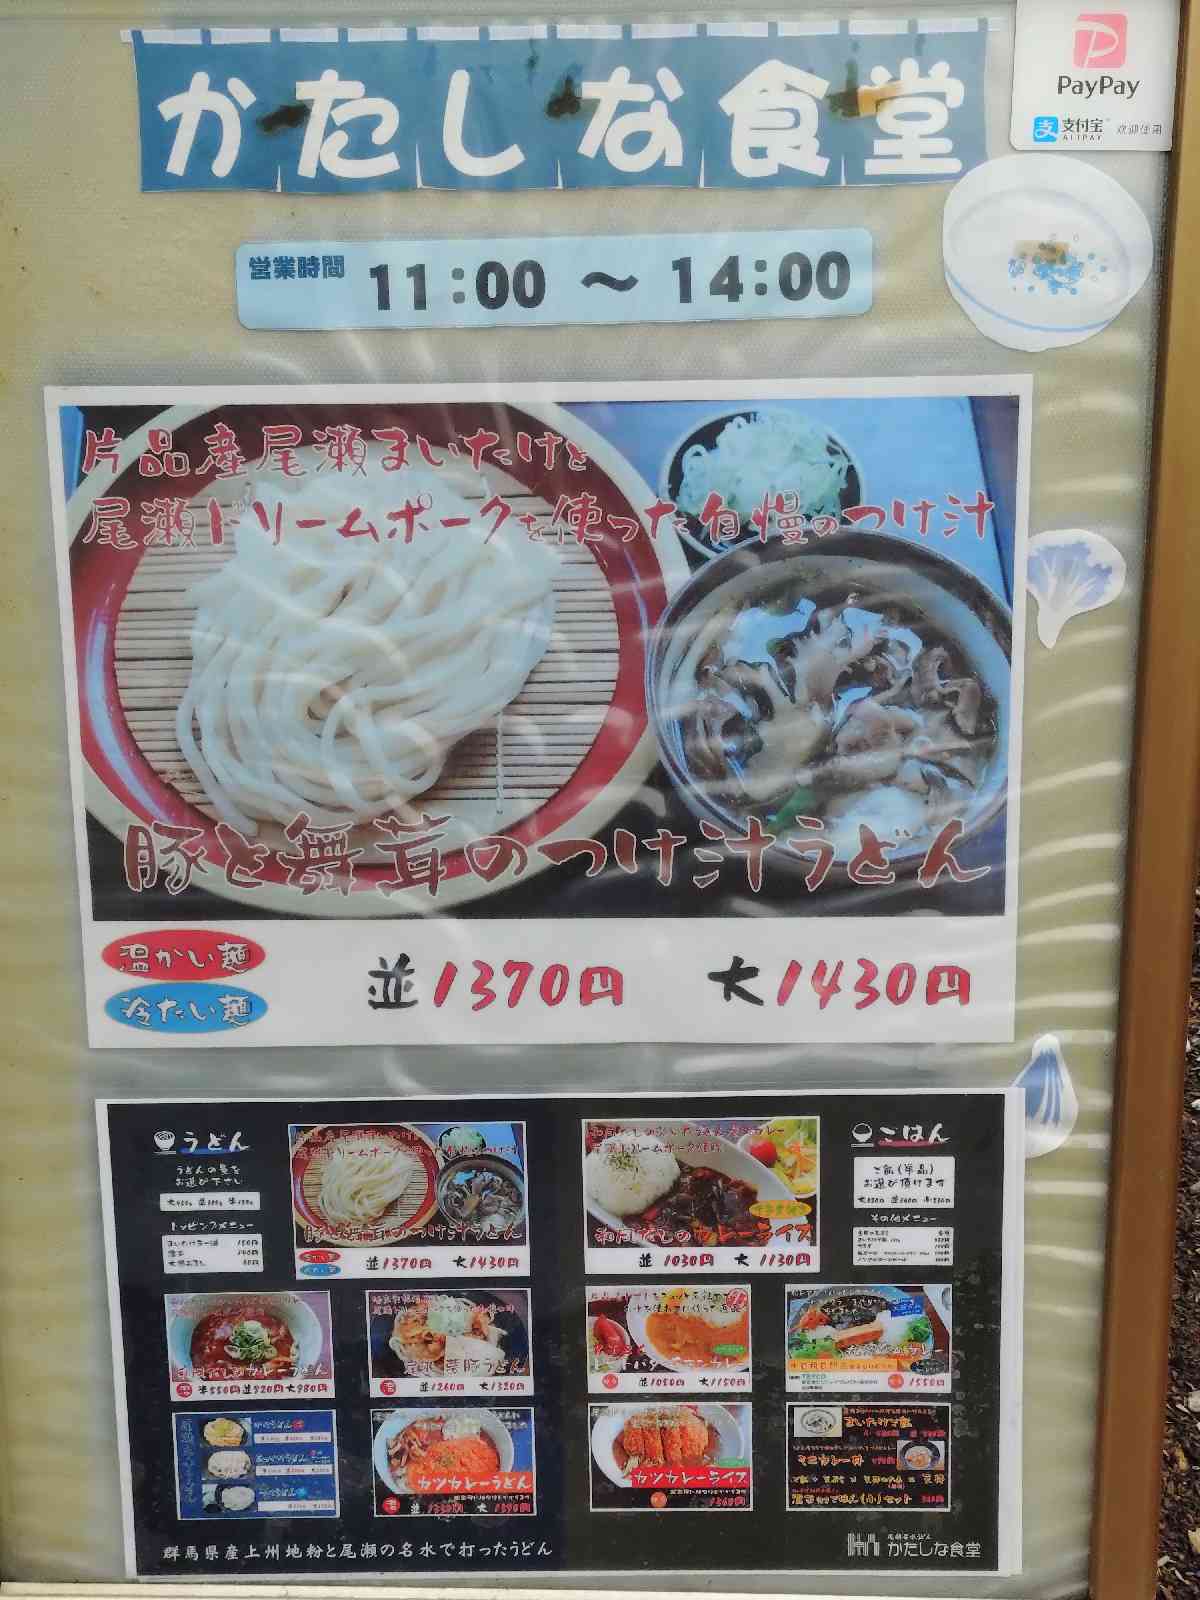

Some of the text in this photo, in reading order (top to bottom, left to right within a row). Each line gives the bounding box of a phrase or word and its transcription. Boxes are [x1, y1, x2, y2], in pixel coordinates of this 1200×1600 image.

[1057, 75, 1140, 99] PayPay
[157, 58, 965, 179] かたしな食堂
[1062, 117, 1104, 133] 支付宝
[248, 254, 345, 281] 営業時間
[369, 259, 546, 312] 11:00
[671, 250, 851, 304] 14:00
[81, 421, 589, 479] 片品産尾瀬まいたけと
[83, 490, 996, 550] 尾瀬ドリームポークを使った自慢のつけ汁
[123, 810, 992, 897] 豚と舞茸のつけ汁うどん
[183, 1130, 251, 1153] うどん
[879, 1122, 951, 1144] ごはん
[417, 1474, 533, 1491] カツカレーうどん
[633, 1470, 749, 1487] カツカレーライス
[162, 1541, 553, 1562] 群馬県産上州地粉と尾瀬の名水で打ったうどん
[887, 1540, 981, 1558] かたしな食堂
